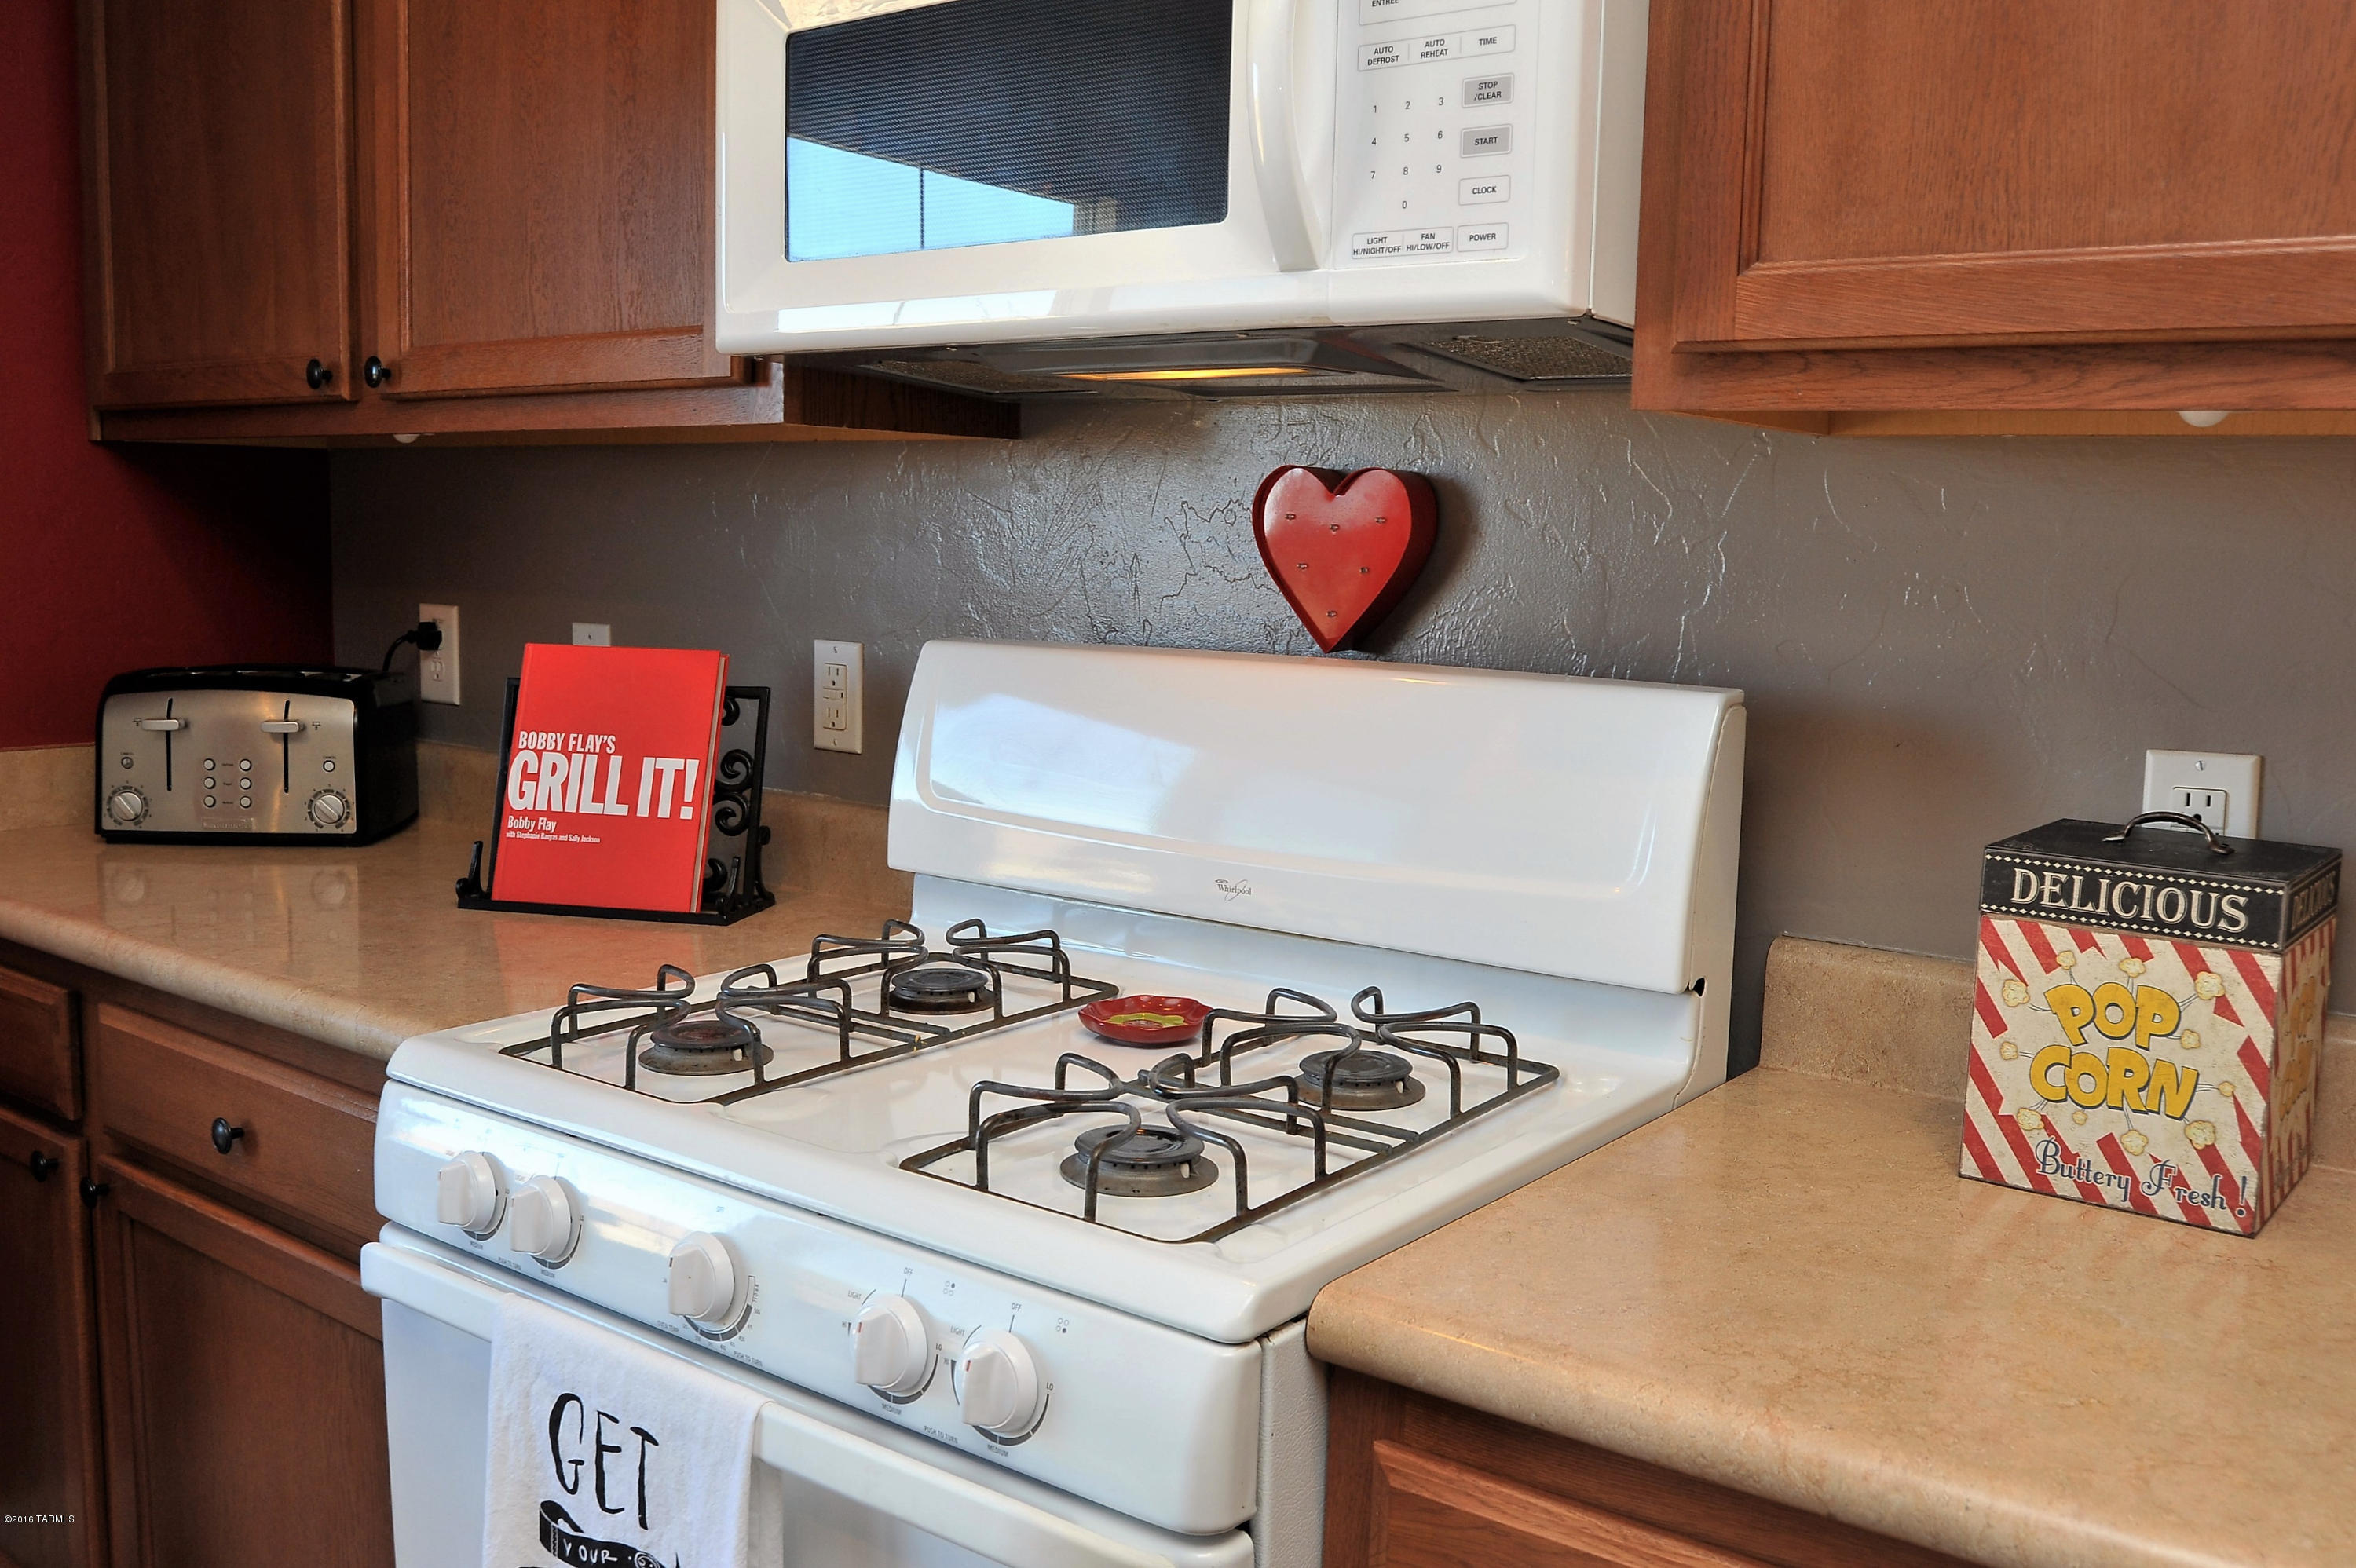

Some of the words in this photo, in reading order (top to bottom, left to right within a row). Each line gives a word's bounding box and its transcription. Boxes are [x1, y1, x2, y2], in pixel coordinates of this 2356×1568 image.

[1425, 39, 1445, 48] AUTO
[1479, 37, 1497, 46] TIME
[1374, 46, 1394, 55] AUTO
[1421, 49, 1448, 59] REHEAT
[1367, 55, 1399, 66] DEFROST
[1478, 81, 1498, 90] STOP
[1474, 91, 1502, 101] /CLEAR
[1405, 101, 1410, 110] 2
[1438, 97, 1444, 106] 3
[1403, 133, 1410, 143] 5
[1437, 130, 1443, 140] 6
[1371, 137, 1377, 146] 4
[1474, 137, 1498, 146] START
[1403, 166, 1409, 176] 8
[1436, 164, 1442, 174] 9
[1370, 170, 1376, 180] 7
[1472, 185, 1497, 195] CLOCK
[1366, 236, 1388, 245] LIGHT
[1469, 232, 1497, 242] POWER
[1353, 245, 1402, 256] HI/NIGHT/OFF
[1406, 242, 1450, 252] HI/LOW/OFF
[519, 731, 565, 751] BOBBY
[568, 733, 616, 754] FLAY'S
[507, 749, 629, 817] GRILL
[636, 756, 700, 820] IT!
[507, 815, 536, 832] Bobby
[537, 817, 557, 833] Flay
[1217, 883, 1252, 896] Whirlpool
[2010, 868, 2248, 933] DELICIOUS
[2044, 981, 2181, 1051] POP
[2029, 1044, 2200, 1120] CORN
[2035, 1136, 2130, 1203] Buttery
[2140, 1159, 2226, 1210] Fresh
[1011, 1302, 1022, 1312] OFF
[950, 1325, 965, 1336] LIGHT
[1046, 1382, 1054, 1391] LO
[549, 1393, 660, 1531] GET
[562, 1539, 618, 1564] YOUR
